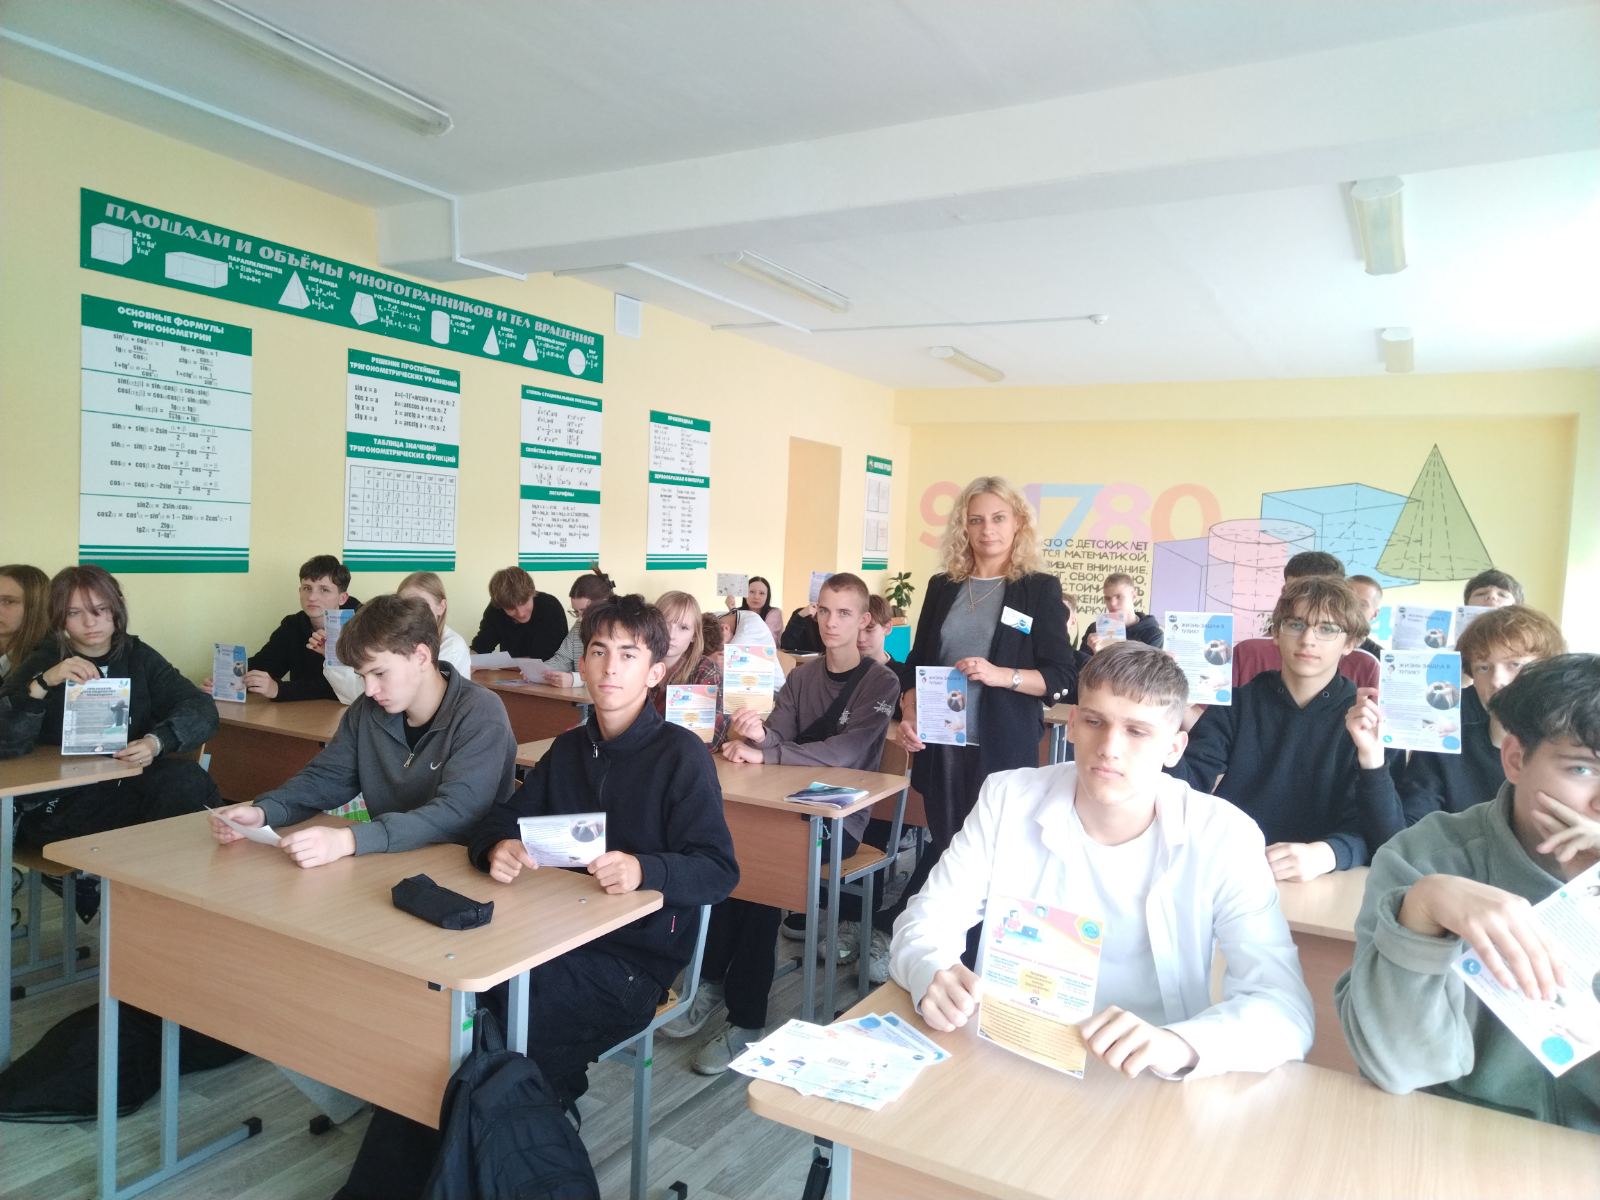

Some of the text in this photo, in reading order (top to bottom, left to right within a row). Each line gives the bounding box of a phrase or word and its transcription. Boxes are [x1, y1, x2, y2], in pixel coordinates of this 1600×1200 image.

[136, 231, 151, 240] КУБ
[105, 203, 230, 248] ПЛОЩАДИ
[235, 239, 252, 254] И
[259, 246, 343, 278] ОБЪЁМЫ
[348, 271, 493, 318] МНОГОГРАННИКОВ
[496, 310, 507, 322] И
[510, 314, 530, 328] ТЕЛ
[534, 321, 594, 345] ВРАЩЕНИЯ
[118, 306, 224, 334] ОСНОВНЫЕ ФОРМУЛЫ
[132, 320, 212, 342] ТРИГОНОМЕТРИИ
[350, 362, 458, 387] ТРИГОНОМЕТРИЧЕСКИХ УРАВНЕНИЙ
[371, 357, 440, 375] РЕШЕНИЕ ПРОСТЕЙШИХ
[349, 445, 456, 463] ТРИГОНОМЕТРИЧЕСКИХ ФУНКЦИЙ
[373, 438, 436, 452] ТАБЛИЦА ЗНАЧЕНИЙ
[1065, 539, 1073, 547] С
[1076, 540, 1128, 550] ДЕТСКИХ
[1130, 541, 1148, 550] ЛЕТ
[1070, 572, 1104, 582] СВОЮ
